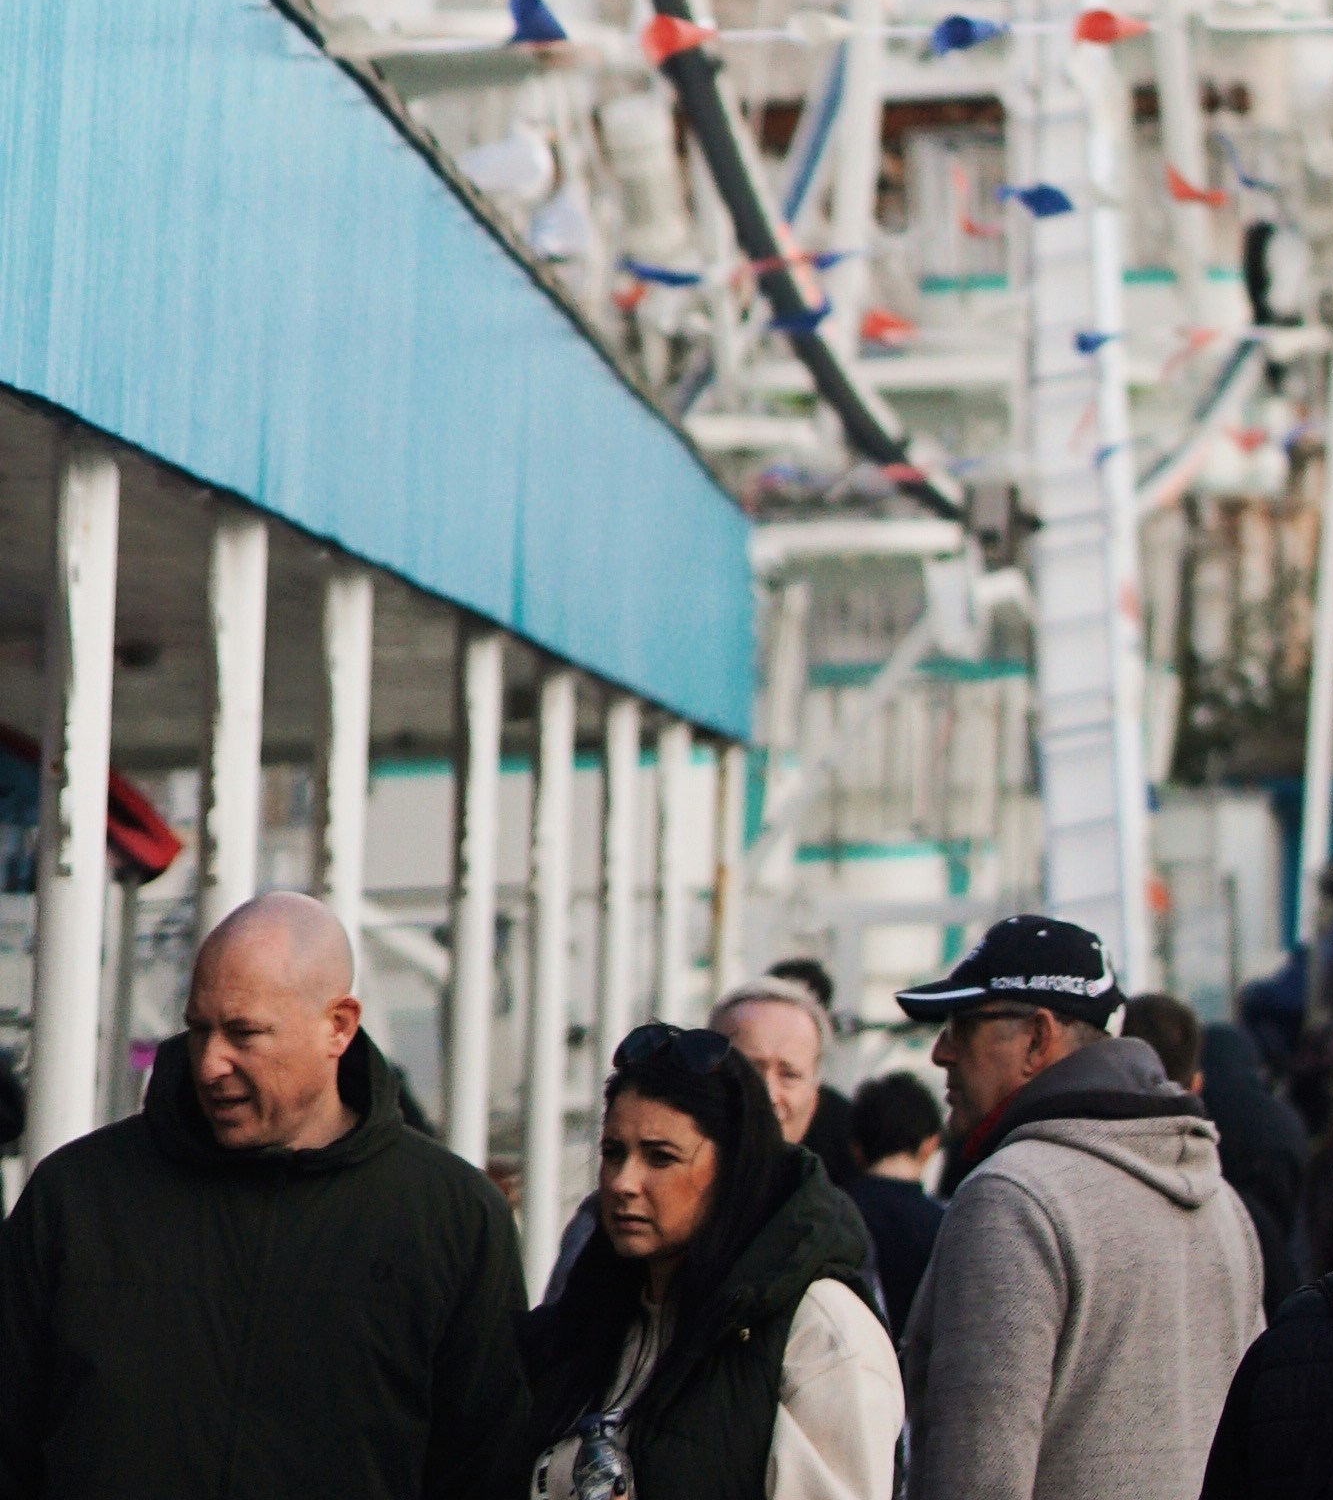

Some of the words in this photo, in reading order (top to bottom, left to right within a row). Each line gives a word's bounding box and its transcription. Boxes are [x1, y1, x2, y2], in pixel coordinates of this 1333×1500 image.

[990, 975, 1027, 989] ROYAL
[1026, 975, 1049, 990] AIR
[1048, 975, 1085, 995] FORCE
